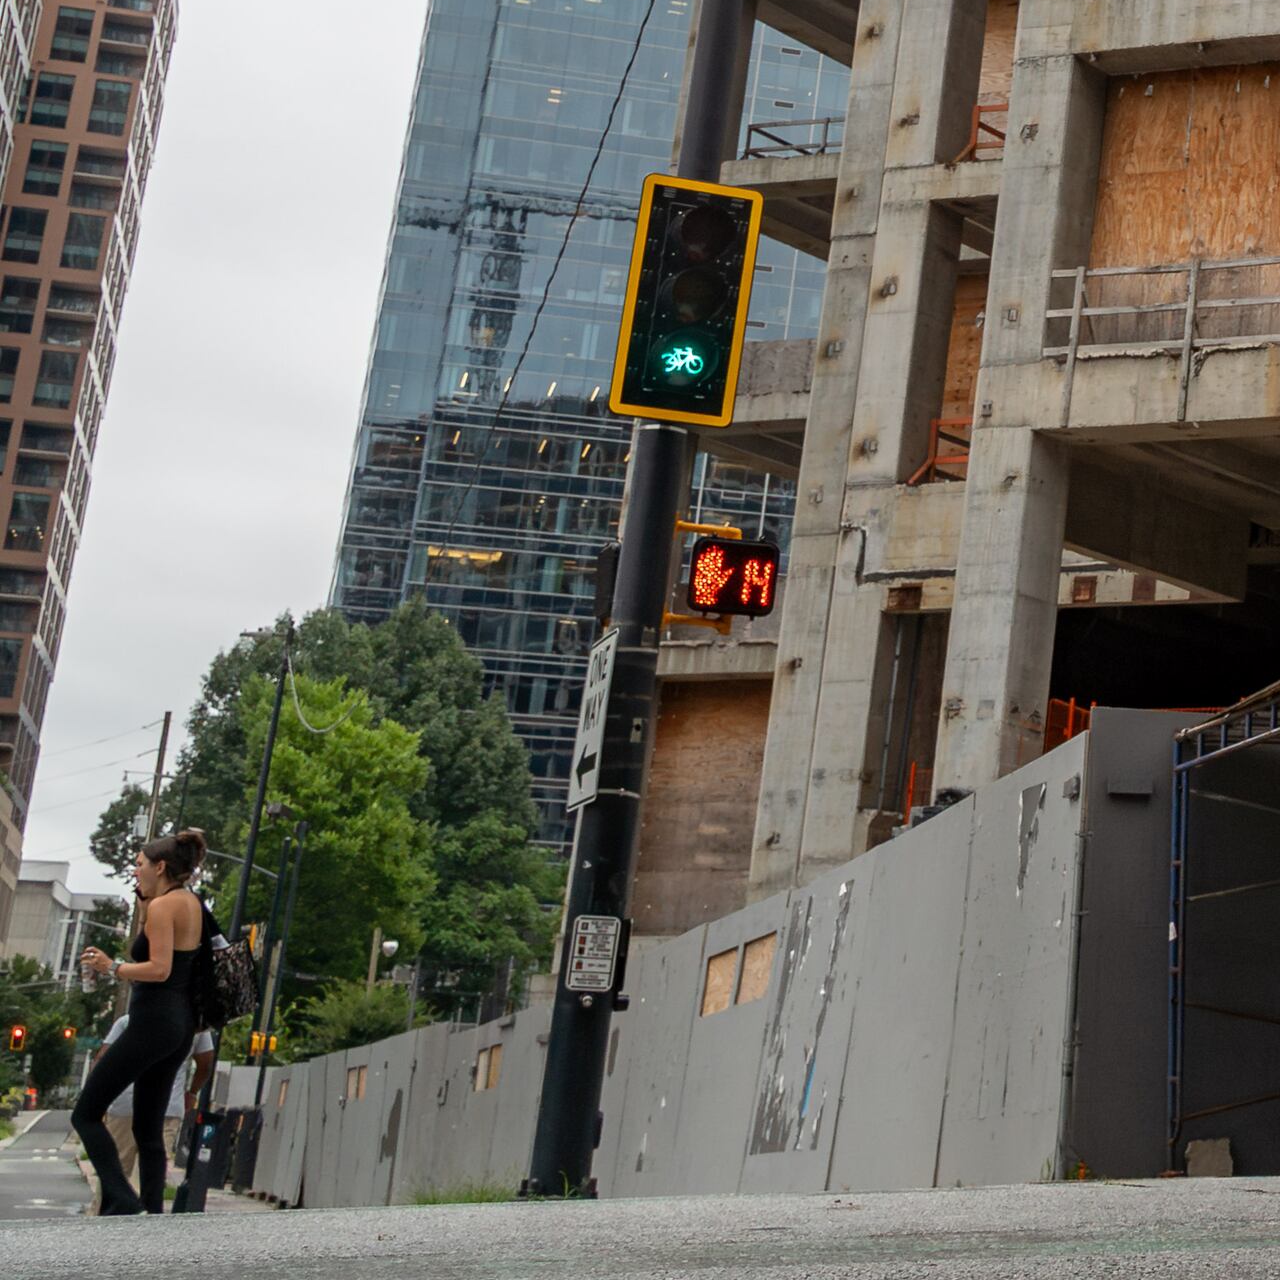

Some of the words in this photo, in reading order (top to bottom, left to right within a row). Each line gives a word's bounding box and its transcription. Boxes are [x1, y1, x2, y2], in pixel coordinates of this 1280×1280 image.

[589, 644, 611, 688] ONE
[583, 689, 605, 732] WAY
[203, 1125, 213, 1139] P
